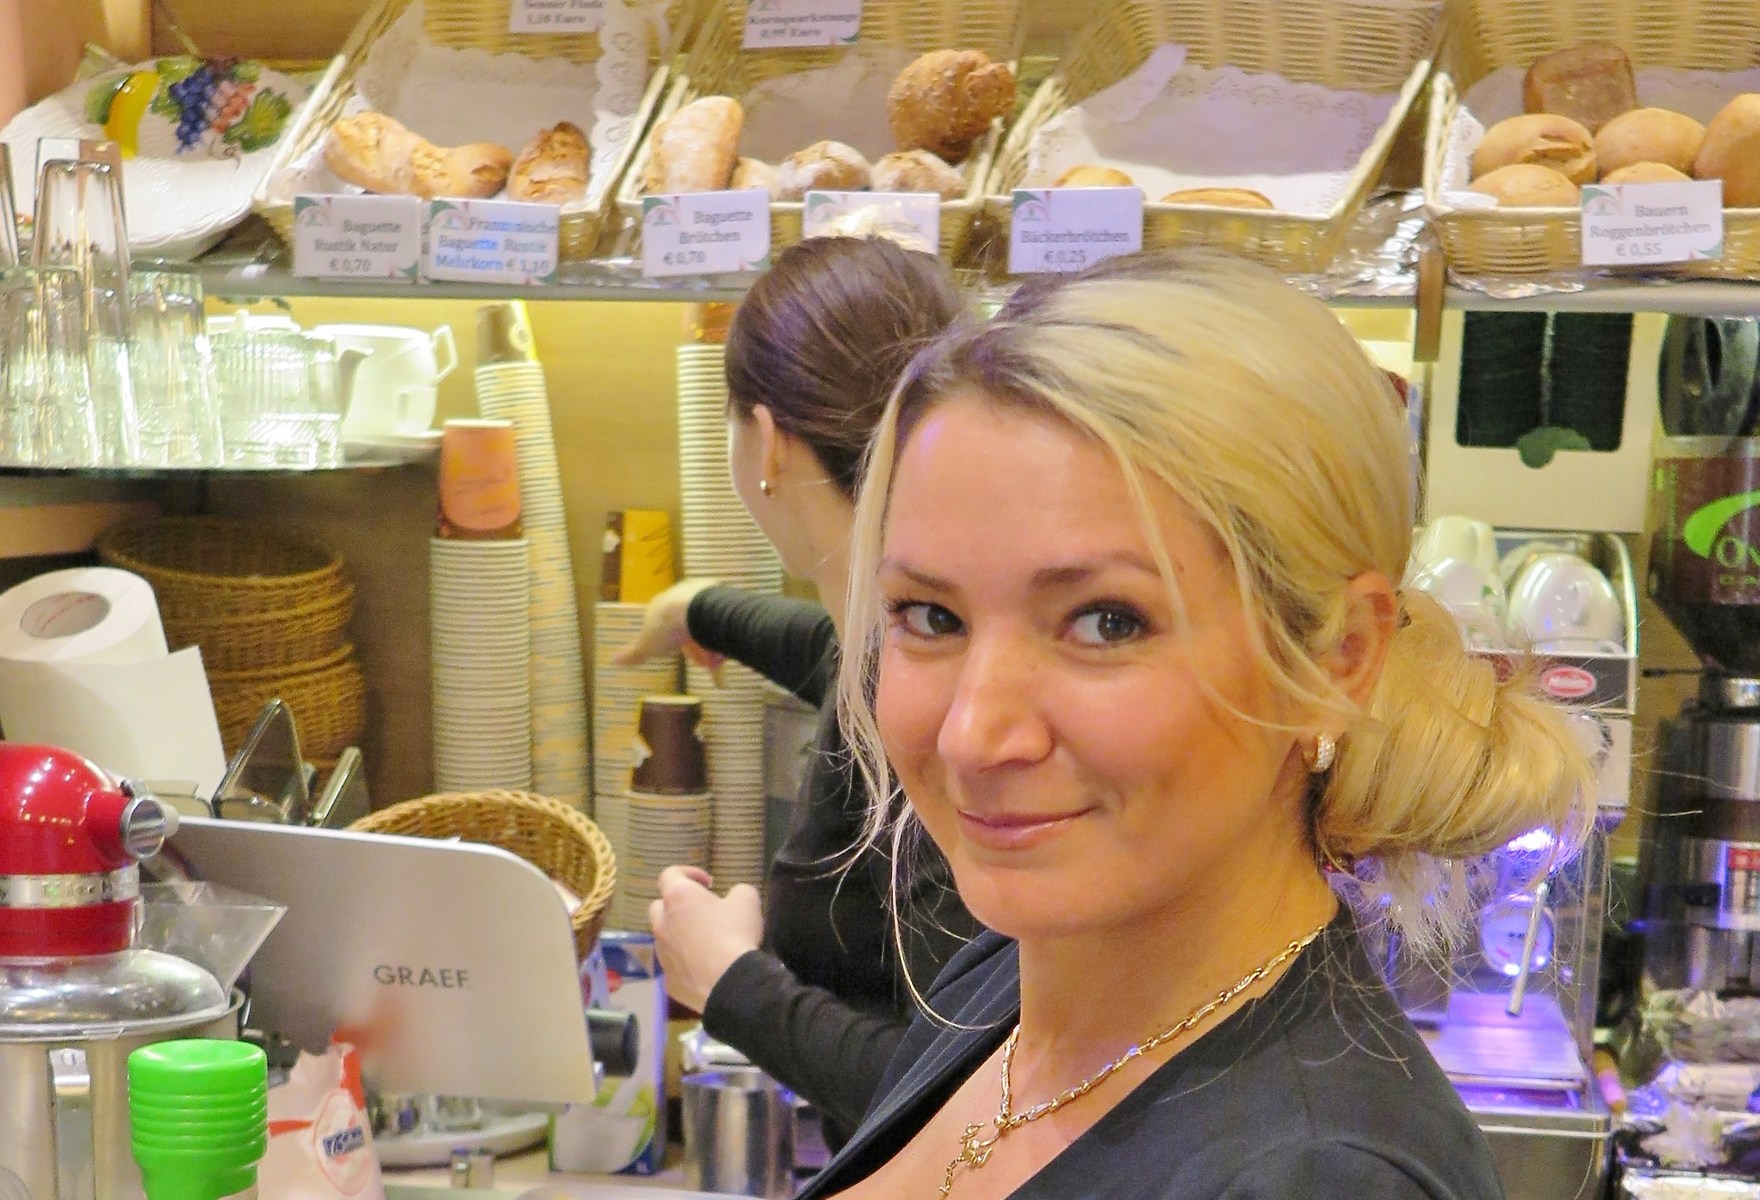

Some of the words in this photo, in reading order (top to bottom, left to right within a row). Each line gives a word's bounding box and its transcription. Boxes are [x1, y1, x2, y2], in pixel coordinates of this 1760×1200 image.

[790, 28, 821, 38] Euro
[693, 210, 754, 227] Baguette
[1634, 204, 1689, 218] Bauern
[342, 218, 402, 236] Baguette
[438, 235, 499, 251] Baguette
[435, 254, 504, 270] Mehrkorn
[373, 964, 470, 989] GRAEF
